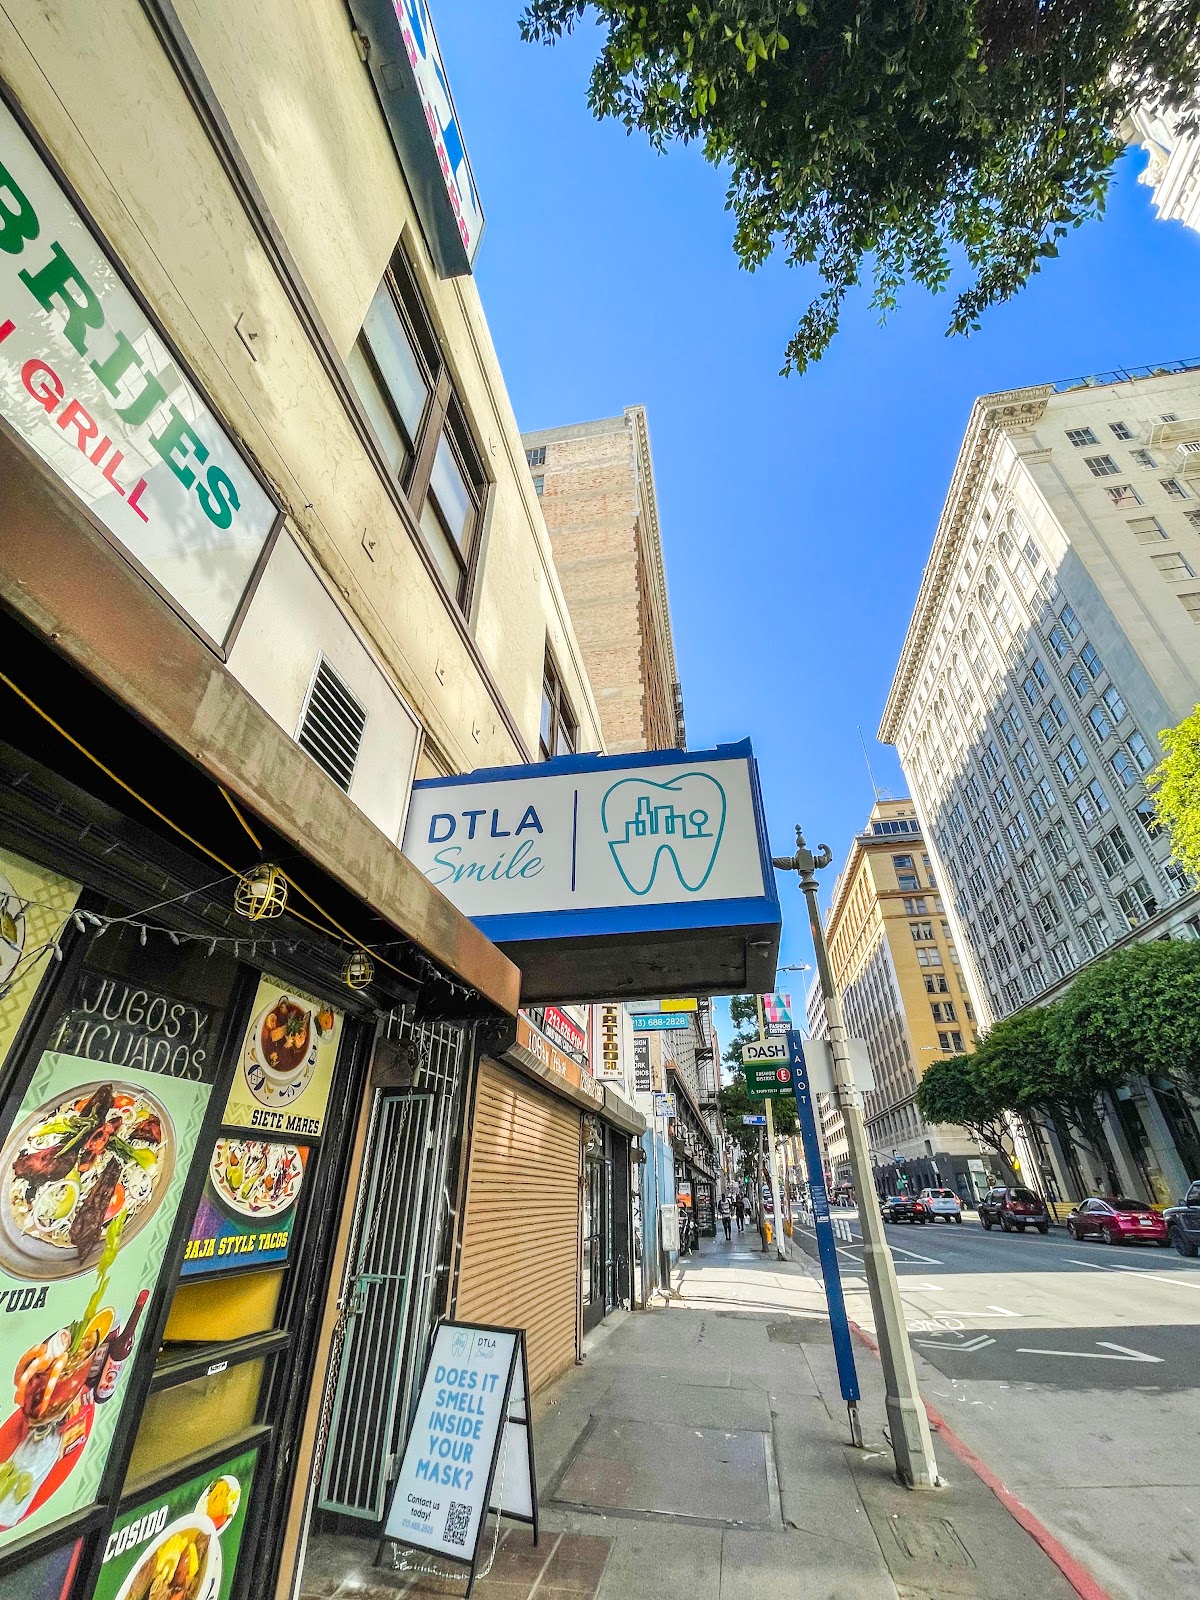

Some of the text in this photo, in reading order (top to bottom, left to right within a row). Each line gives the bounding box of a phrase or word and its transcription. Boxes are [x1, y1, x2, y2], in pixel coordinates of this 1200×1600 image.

[0, 161, 240, 530] BRIJES
[21, 358, 149, 523] GRILL
[427, 805, 544, 843] DTLA
[423, 839, 545, 885] Smile
[83, 979, 185, 1038] JUGOS
[648, 1017, 685, 1026] 688-2828
[747, 1045, 786, 1058] DASH
[793, 1042, 807, 1104] LADOT
[251, 1109, 320, 1134] SIETE MARES
[217, 1234, 257, 1255] STYLE
[258, 1232, 288, 1251] TACOS
[477, 1337, 496, 1348] DTLA
[434, 1365, 500, 1393] DOES IT
[435, 1388, 484, 1416] SMELL
[428, 1410, 484, 1440] INSIDE
[429, 1434, 474, 1464] YOUR
[415, 1458, 474, 1491] MASK?
[407, 1493, 440, 1510] Contact us
[410, 1507, 432, 1521] today!
[102, 1504, 169, 1564] COSIDO
